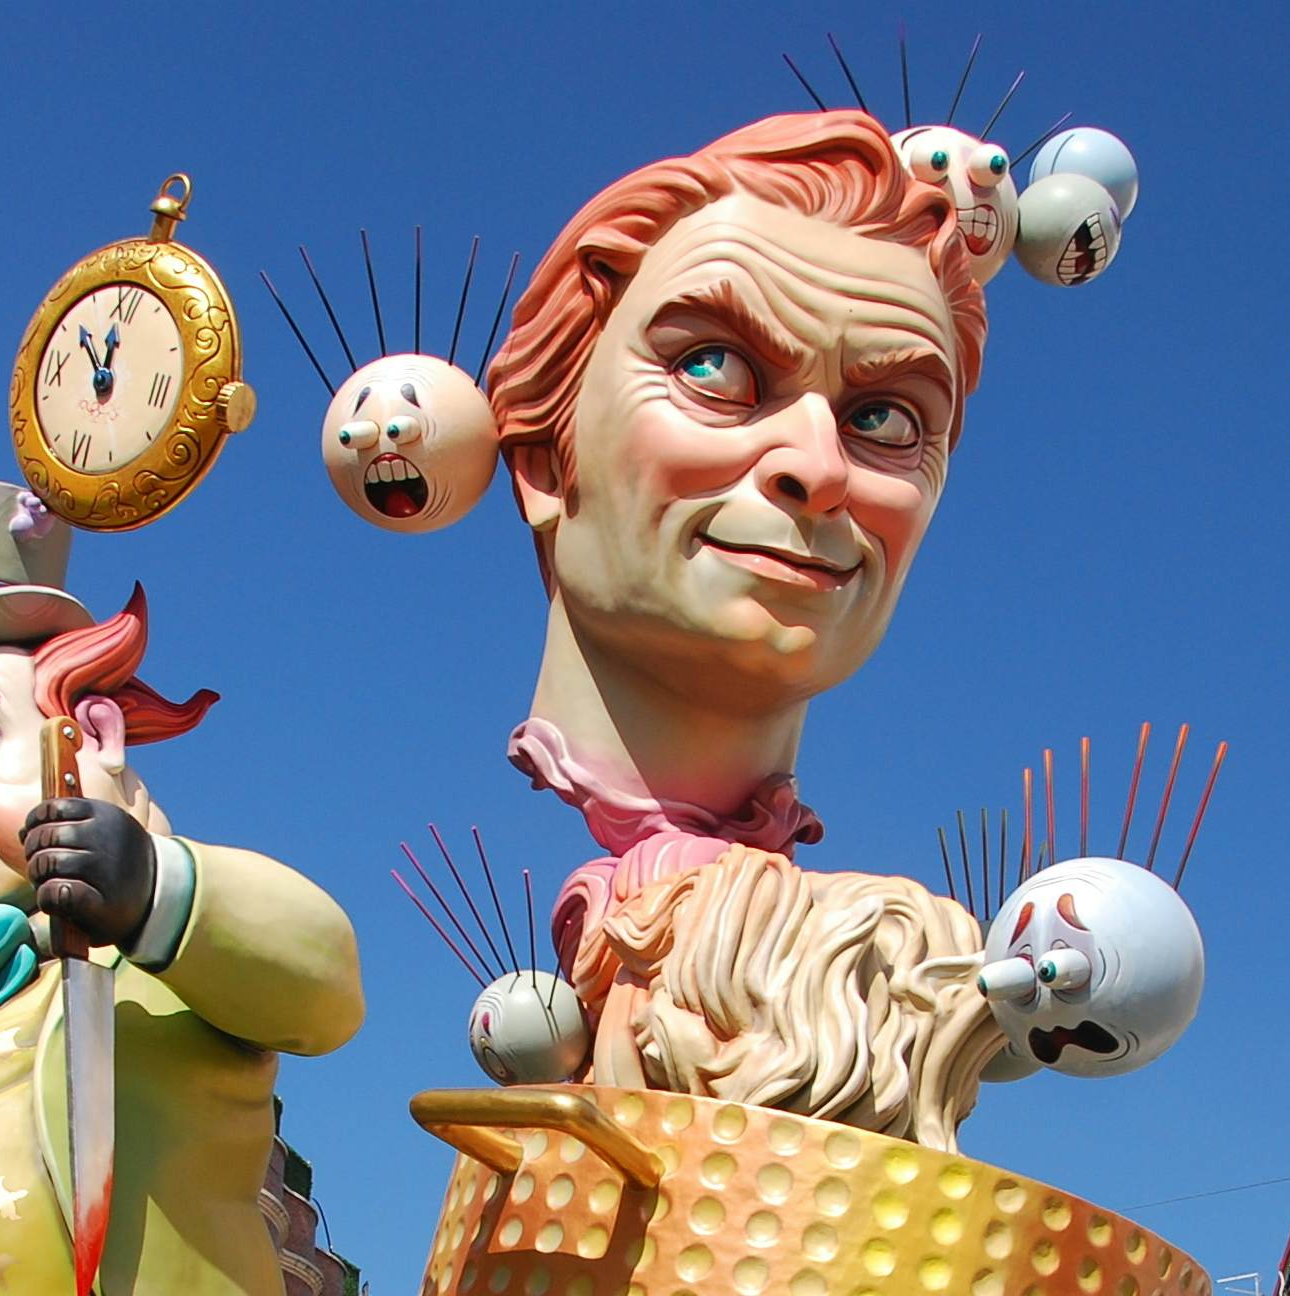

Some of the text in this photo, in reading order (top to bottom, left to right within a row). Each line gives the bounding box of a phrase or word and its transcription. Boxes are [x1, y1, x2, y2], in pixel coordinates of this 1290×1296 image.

[44, 350, 71, 387] IX
[147, 373, 172, 409] III
[71, 430, 92, 468] VI
